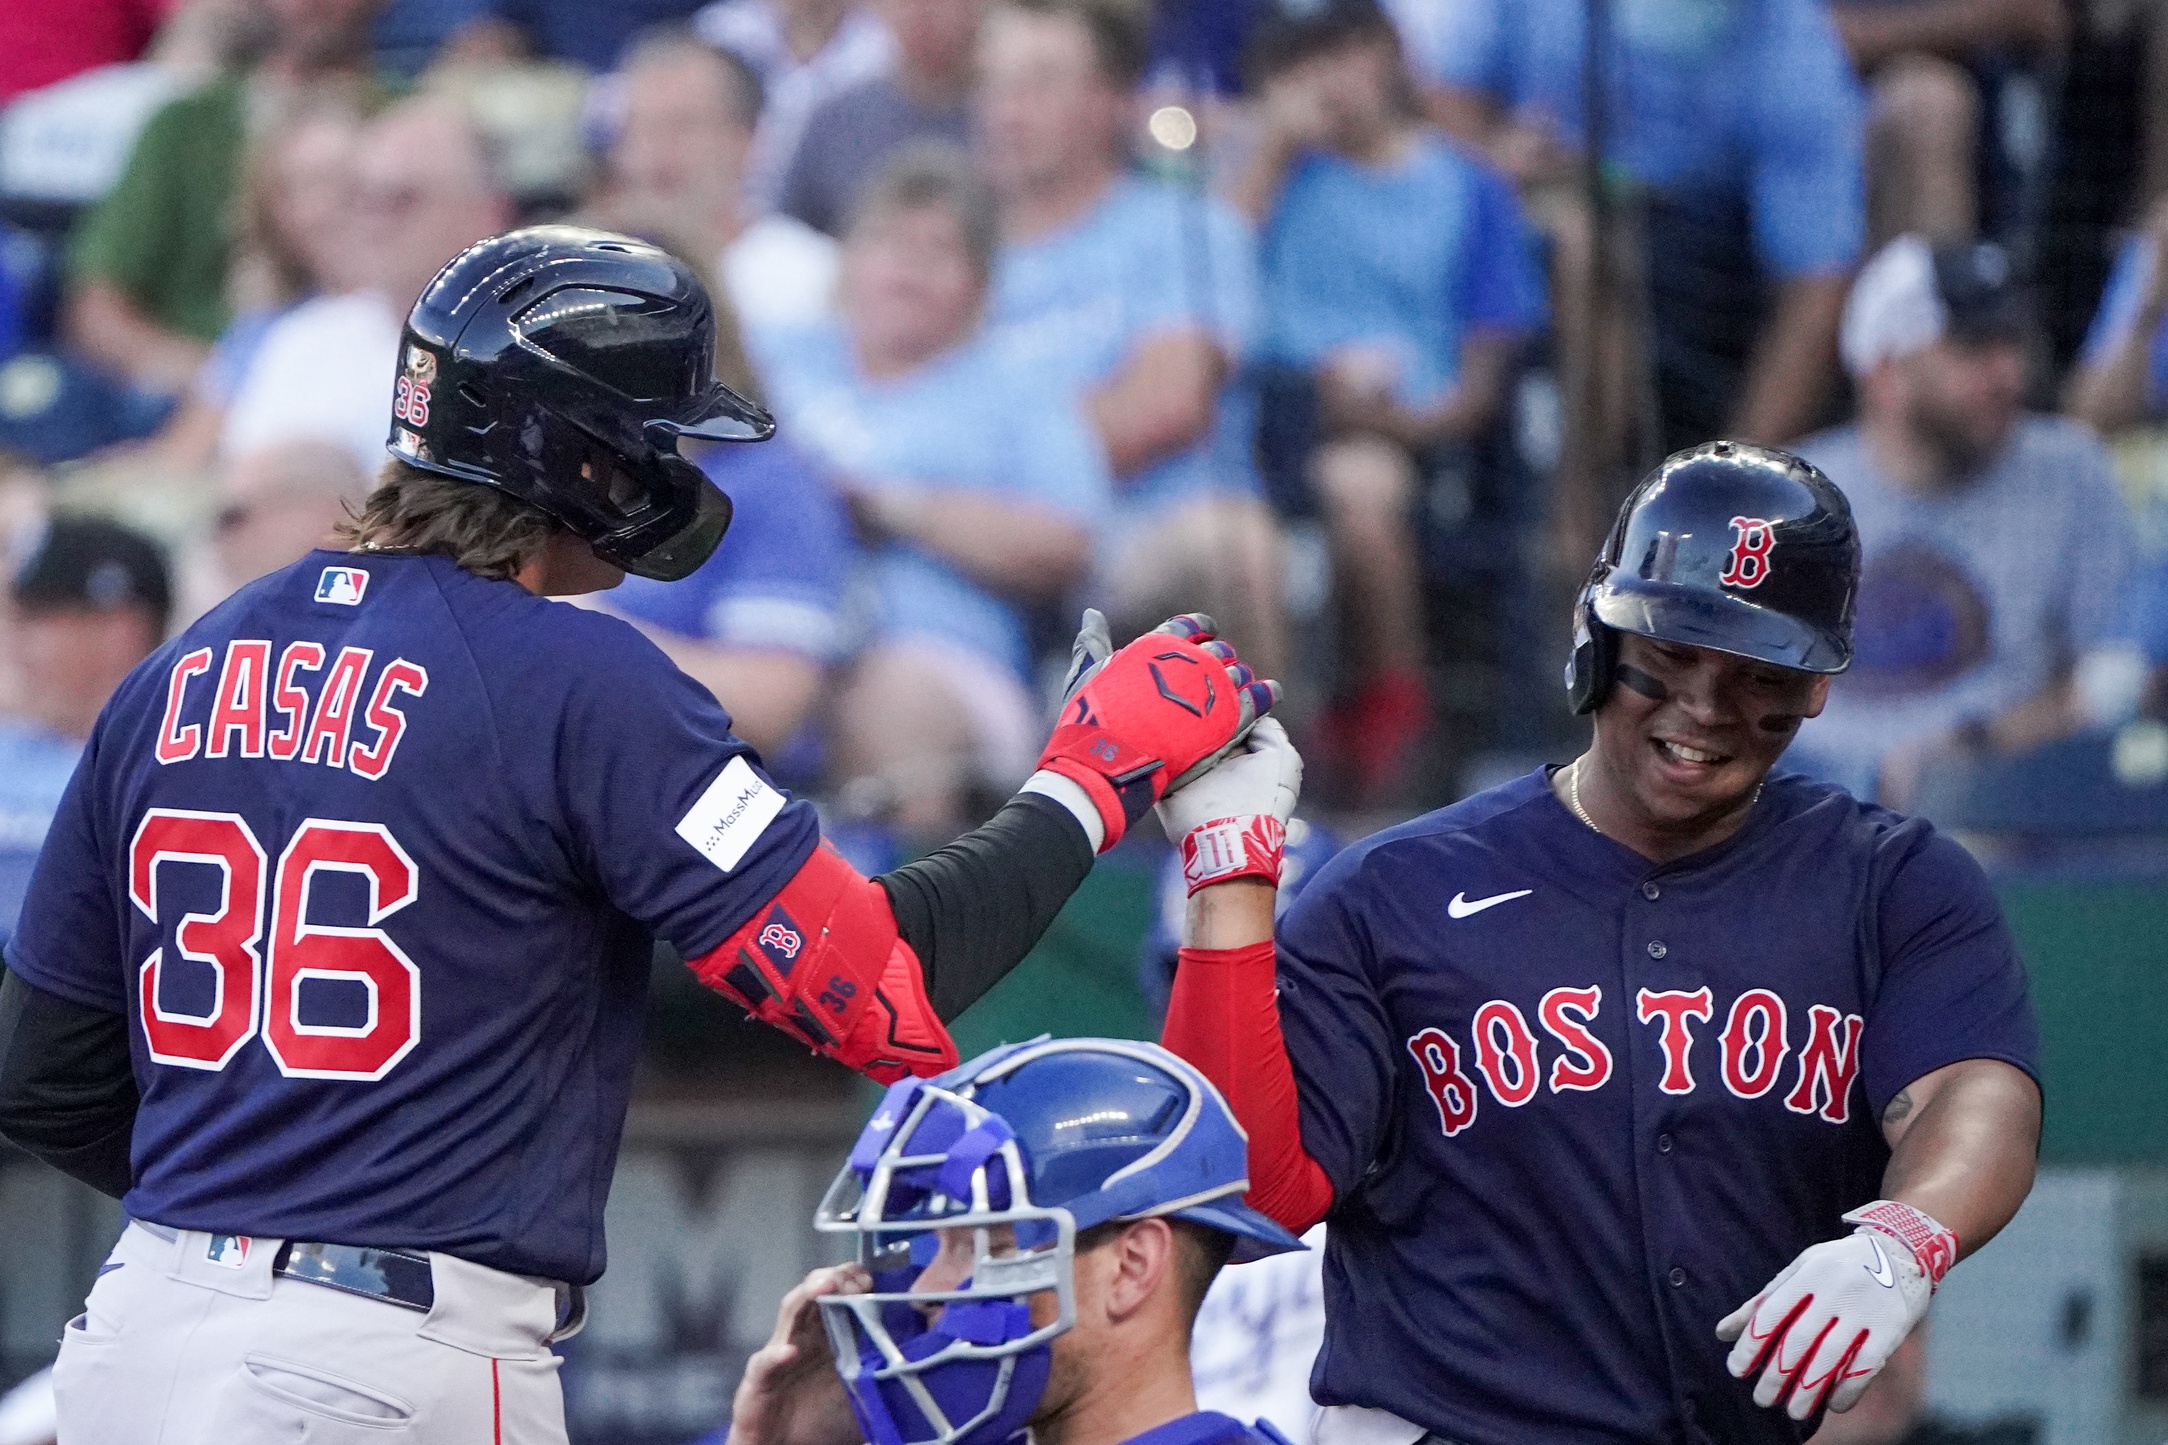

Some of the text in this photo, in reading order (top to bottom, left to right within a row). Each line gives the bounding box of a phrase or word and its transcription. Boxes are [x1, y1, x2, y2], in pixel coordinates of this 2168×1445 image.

[394, 375, 432, 428] 36
[1718, 515, 1778, 589] B
[155, 639, 429, 781] CASAS
[1089, 737, 1119, 762] 36
[1205, 828, 1235, 868] 11
[129, 807, 421, 1082] 36
[758, 923, 802, 959] B
[818, 974, 857, 1014] 36
[1406, 984, 1864, 1138] BOSTON
